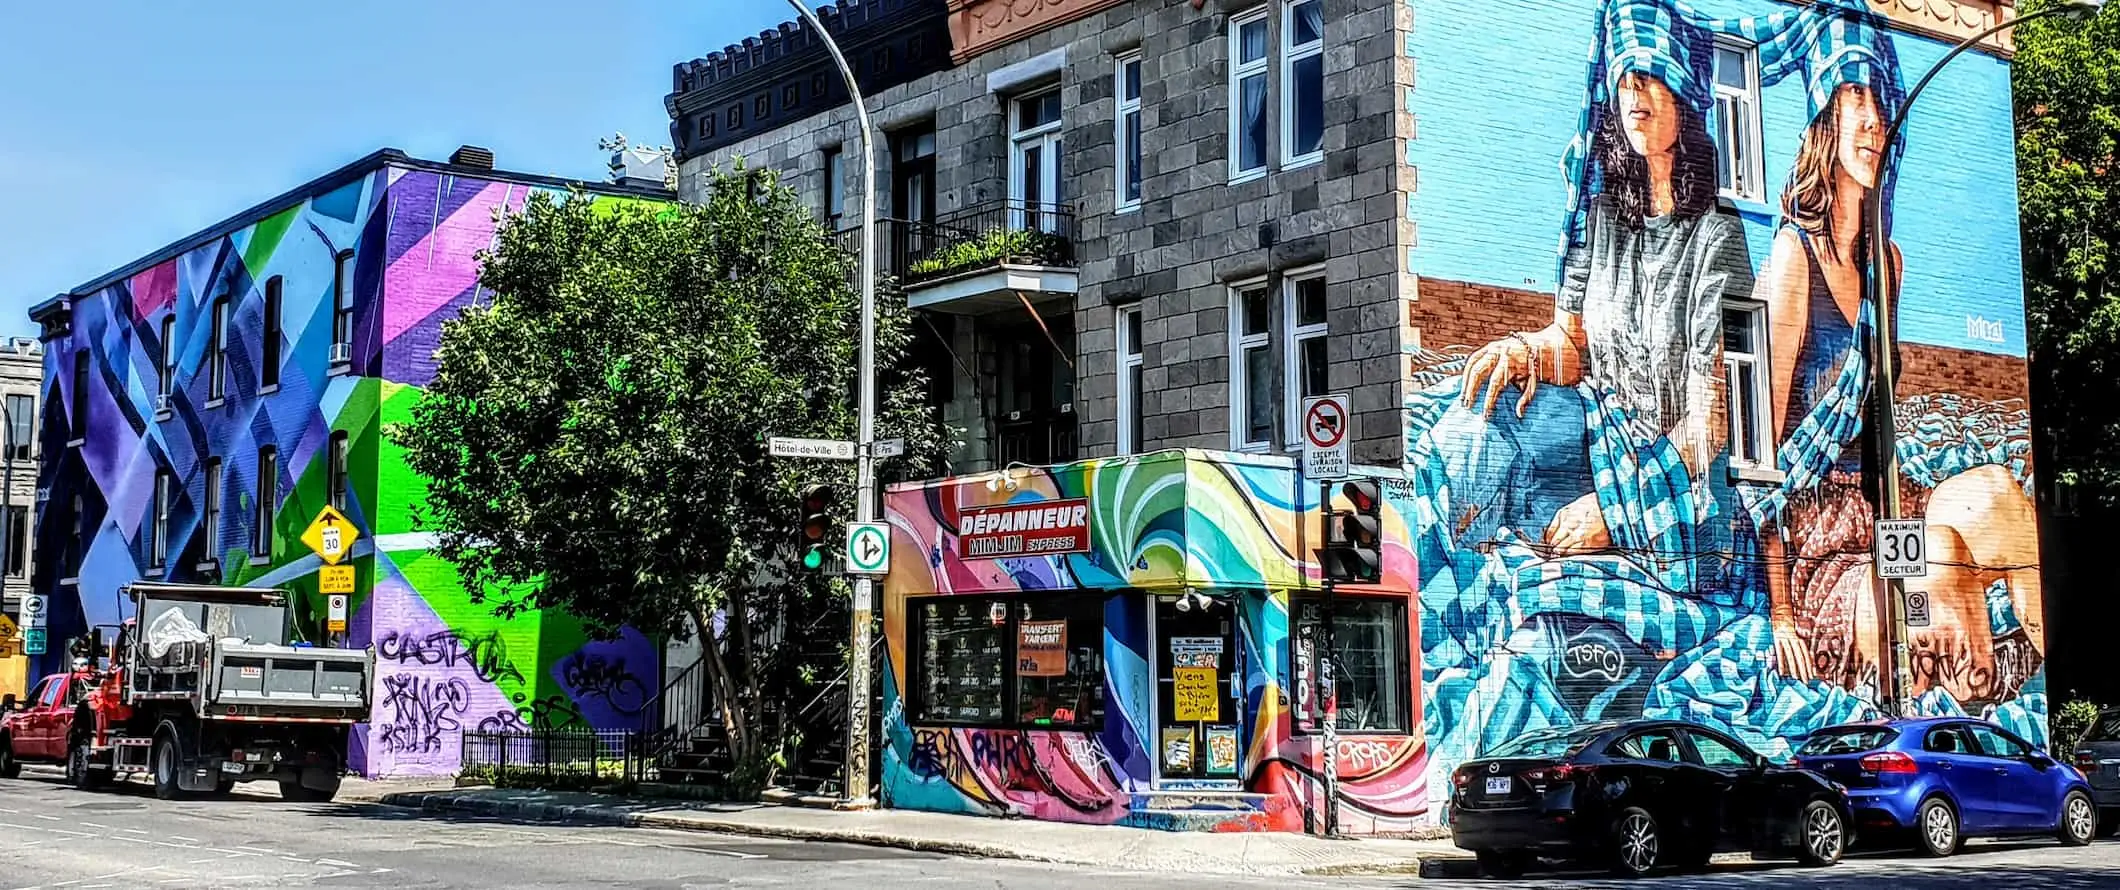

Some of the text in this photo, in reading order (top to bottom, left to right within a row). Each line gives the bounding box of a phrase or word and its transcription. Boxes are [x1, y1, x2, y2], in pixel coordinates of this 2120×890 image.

[1309, 458, 1343, 466] LIVRAISON
[961, 505, 1087, 536] DÉPANNEUR
[1881, 523, 1920, 531] MAXIMUM
[325, 538, 338, 550] 30
[969, 535, 1075, 555] MIMJIM EXPRESS
[1884, 533, 1920, 562] 30
[1884, 565, 1921, 574] SECTEUR
